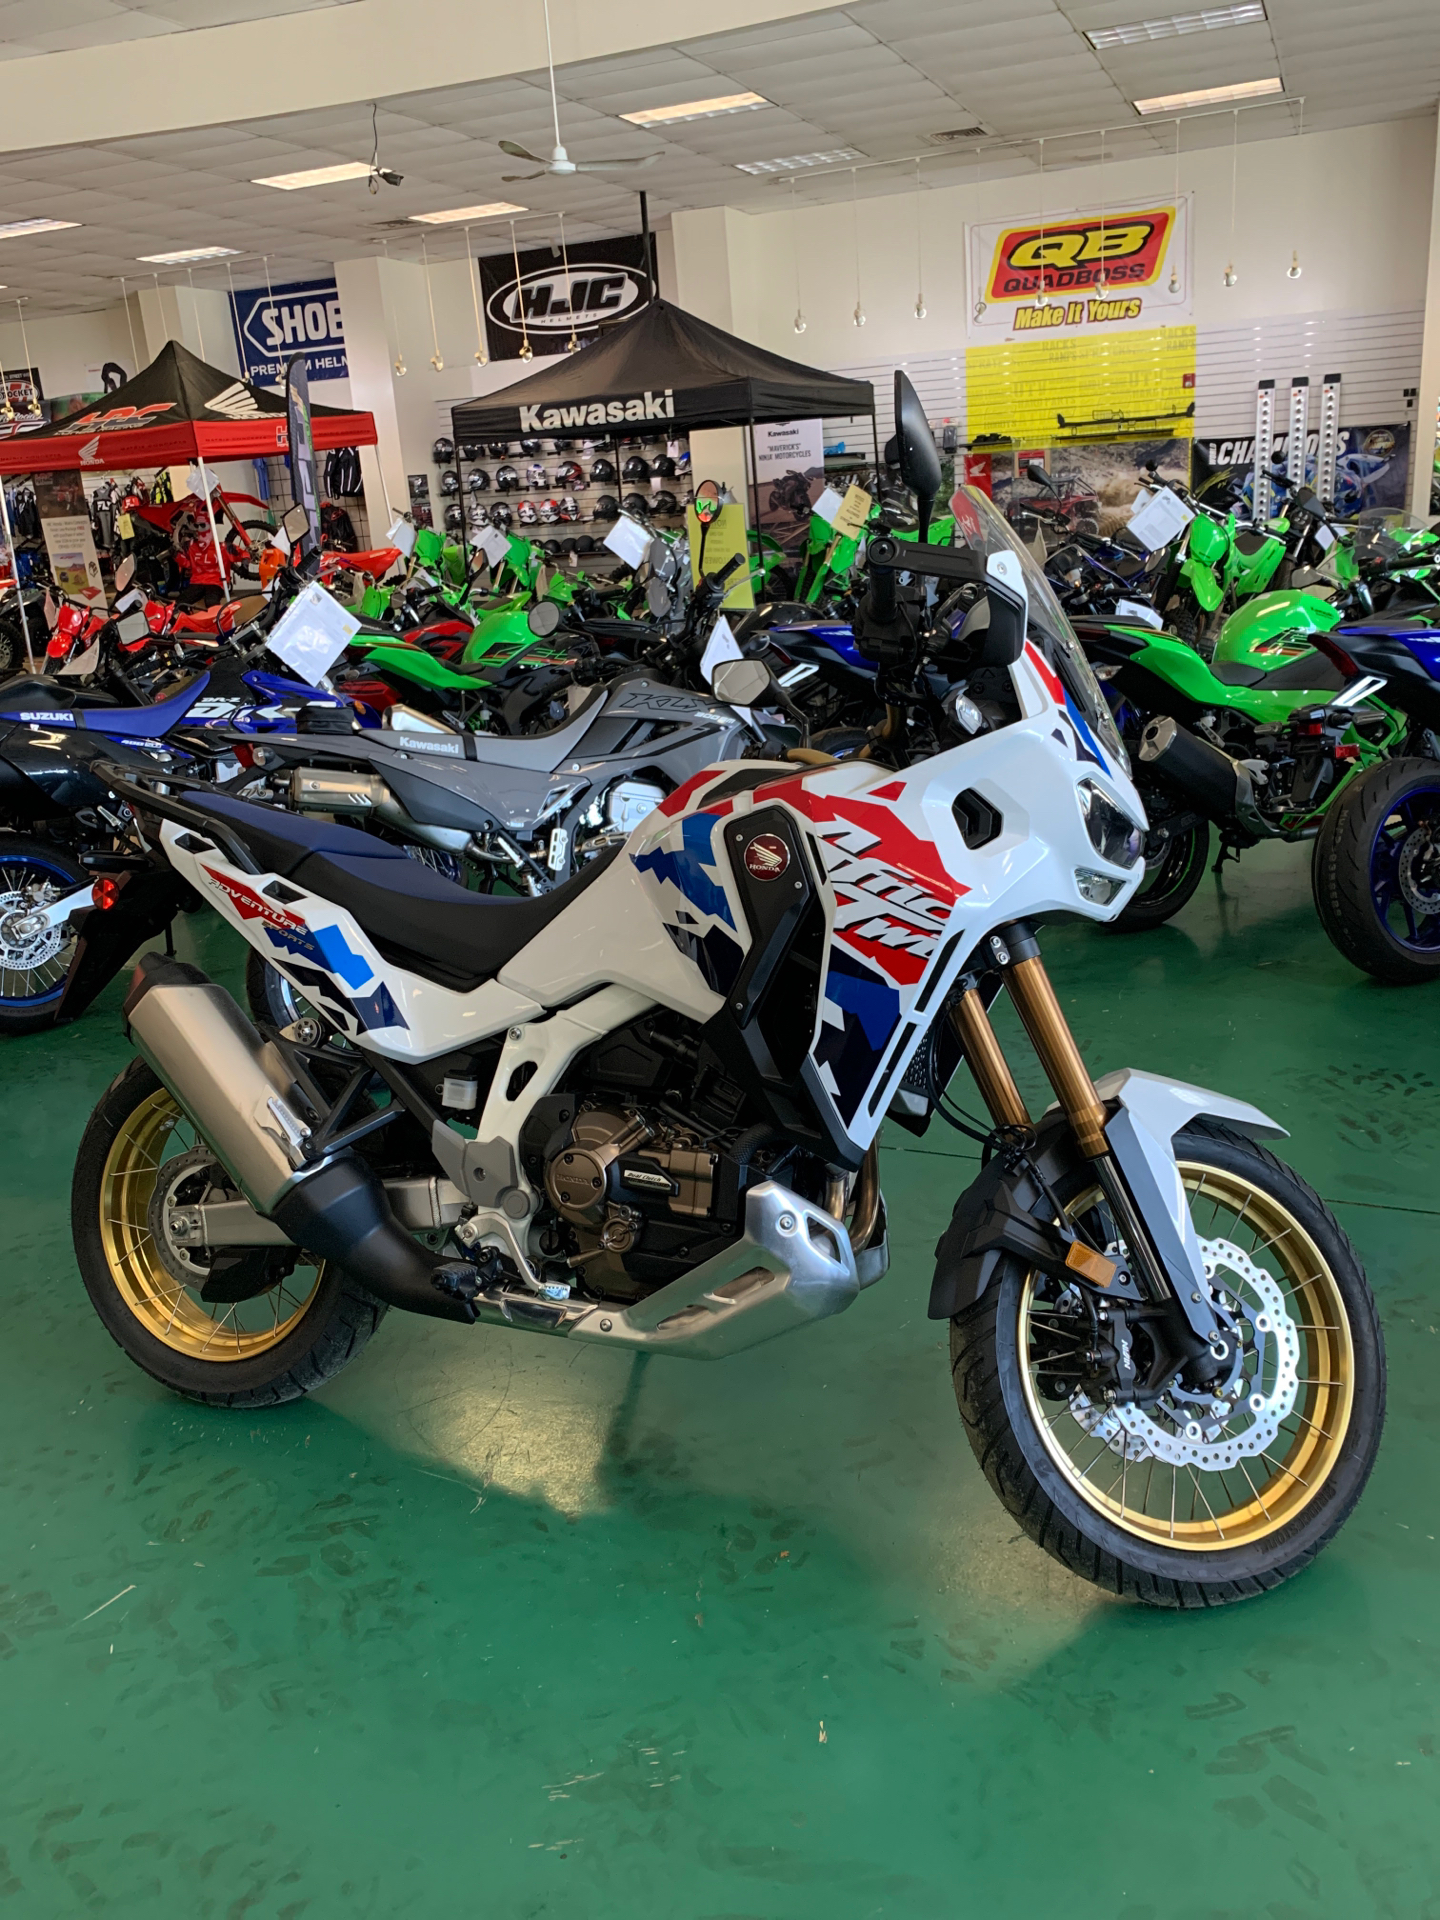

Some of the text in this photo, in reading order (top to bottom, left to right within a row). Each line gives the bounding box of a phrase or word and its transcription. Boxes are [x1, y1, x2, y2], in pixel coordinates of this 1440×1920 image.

[1008, 222, 1152, 269] QB
[1003, 263, 1146, 293] QUADBOSS
[511, 274, 627, 323] HJC
[540, 313, 598, 323] HELMETS
[1013, 297, 1143, 331] Make It Yours
[519, 388, 675, 433] Kawasaki
[768, 429, 799, 438] Kawasaki
[20, 712, 74, 721] SUZUKI
[400, 736, 459, 754] Kawasaki
[749, 863, 781, 873] HONDA
[208, 878, 309, 936] ADVENTURE
[261, 919, 315, 951] SPORTS
[642, 1173, 662, 1182] Clutch
